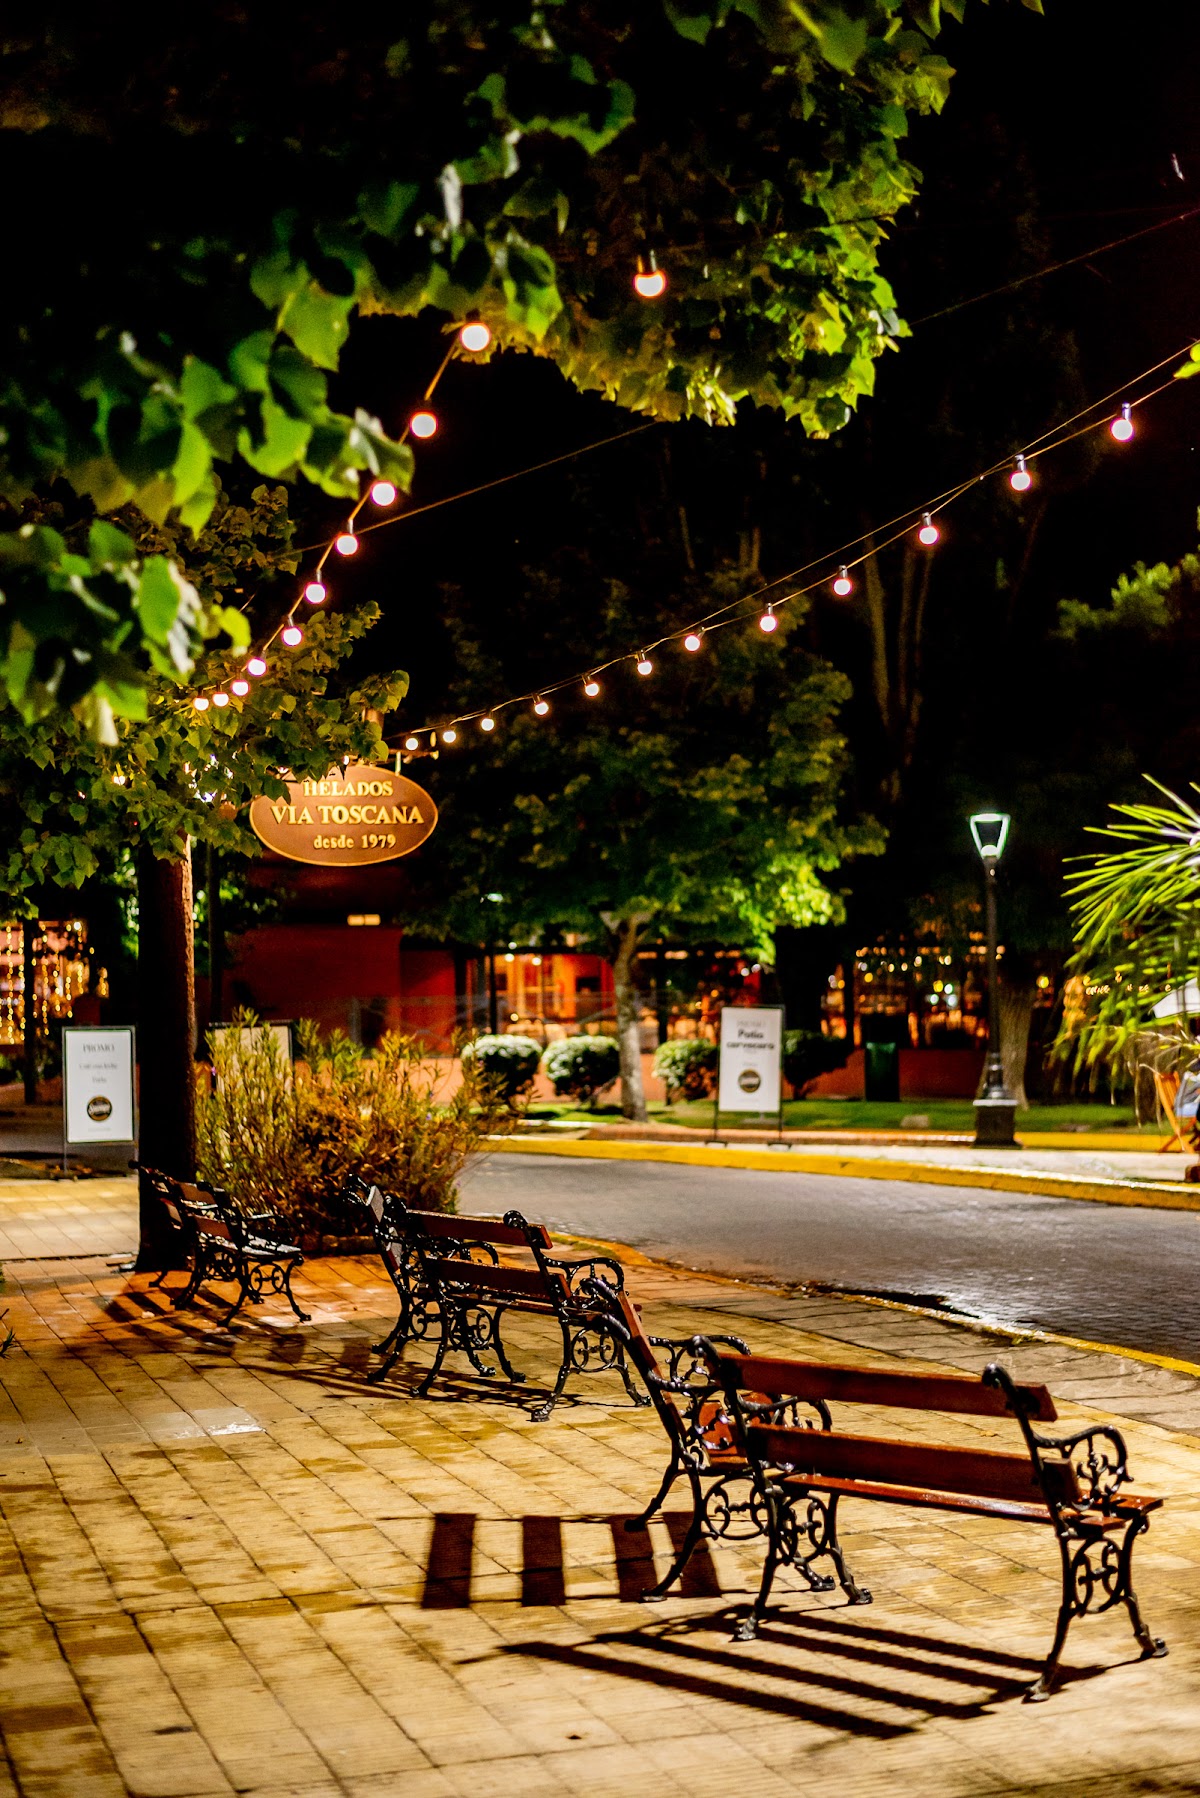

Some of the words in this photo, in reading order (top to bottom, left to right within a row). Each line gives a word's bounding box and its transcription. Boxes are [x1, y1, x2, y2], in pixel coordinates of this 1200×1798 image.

[303, 781, 394, 797] HELADOS
[271, 805, 314, 825] VIA
[318, 805, 424, 825] TOSCANA
[313, 834, 354, 849] desde
[361, 833, 396, 849] 1979
[83, 1043, 115, 1053] PROMO
